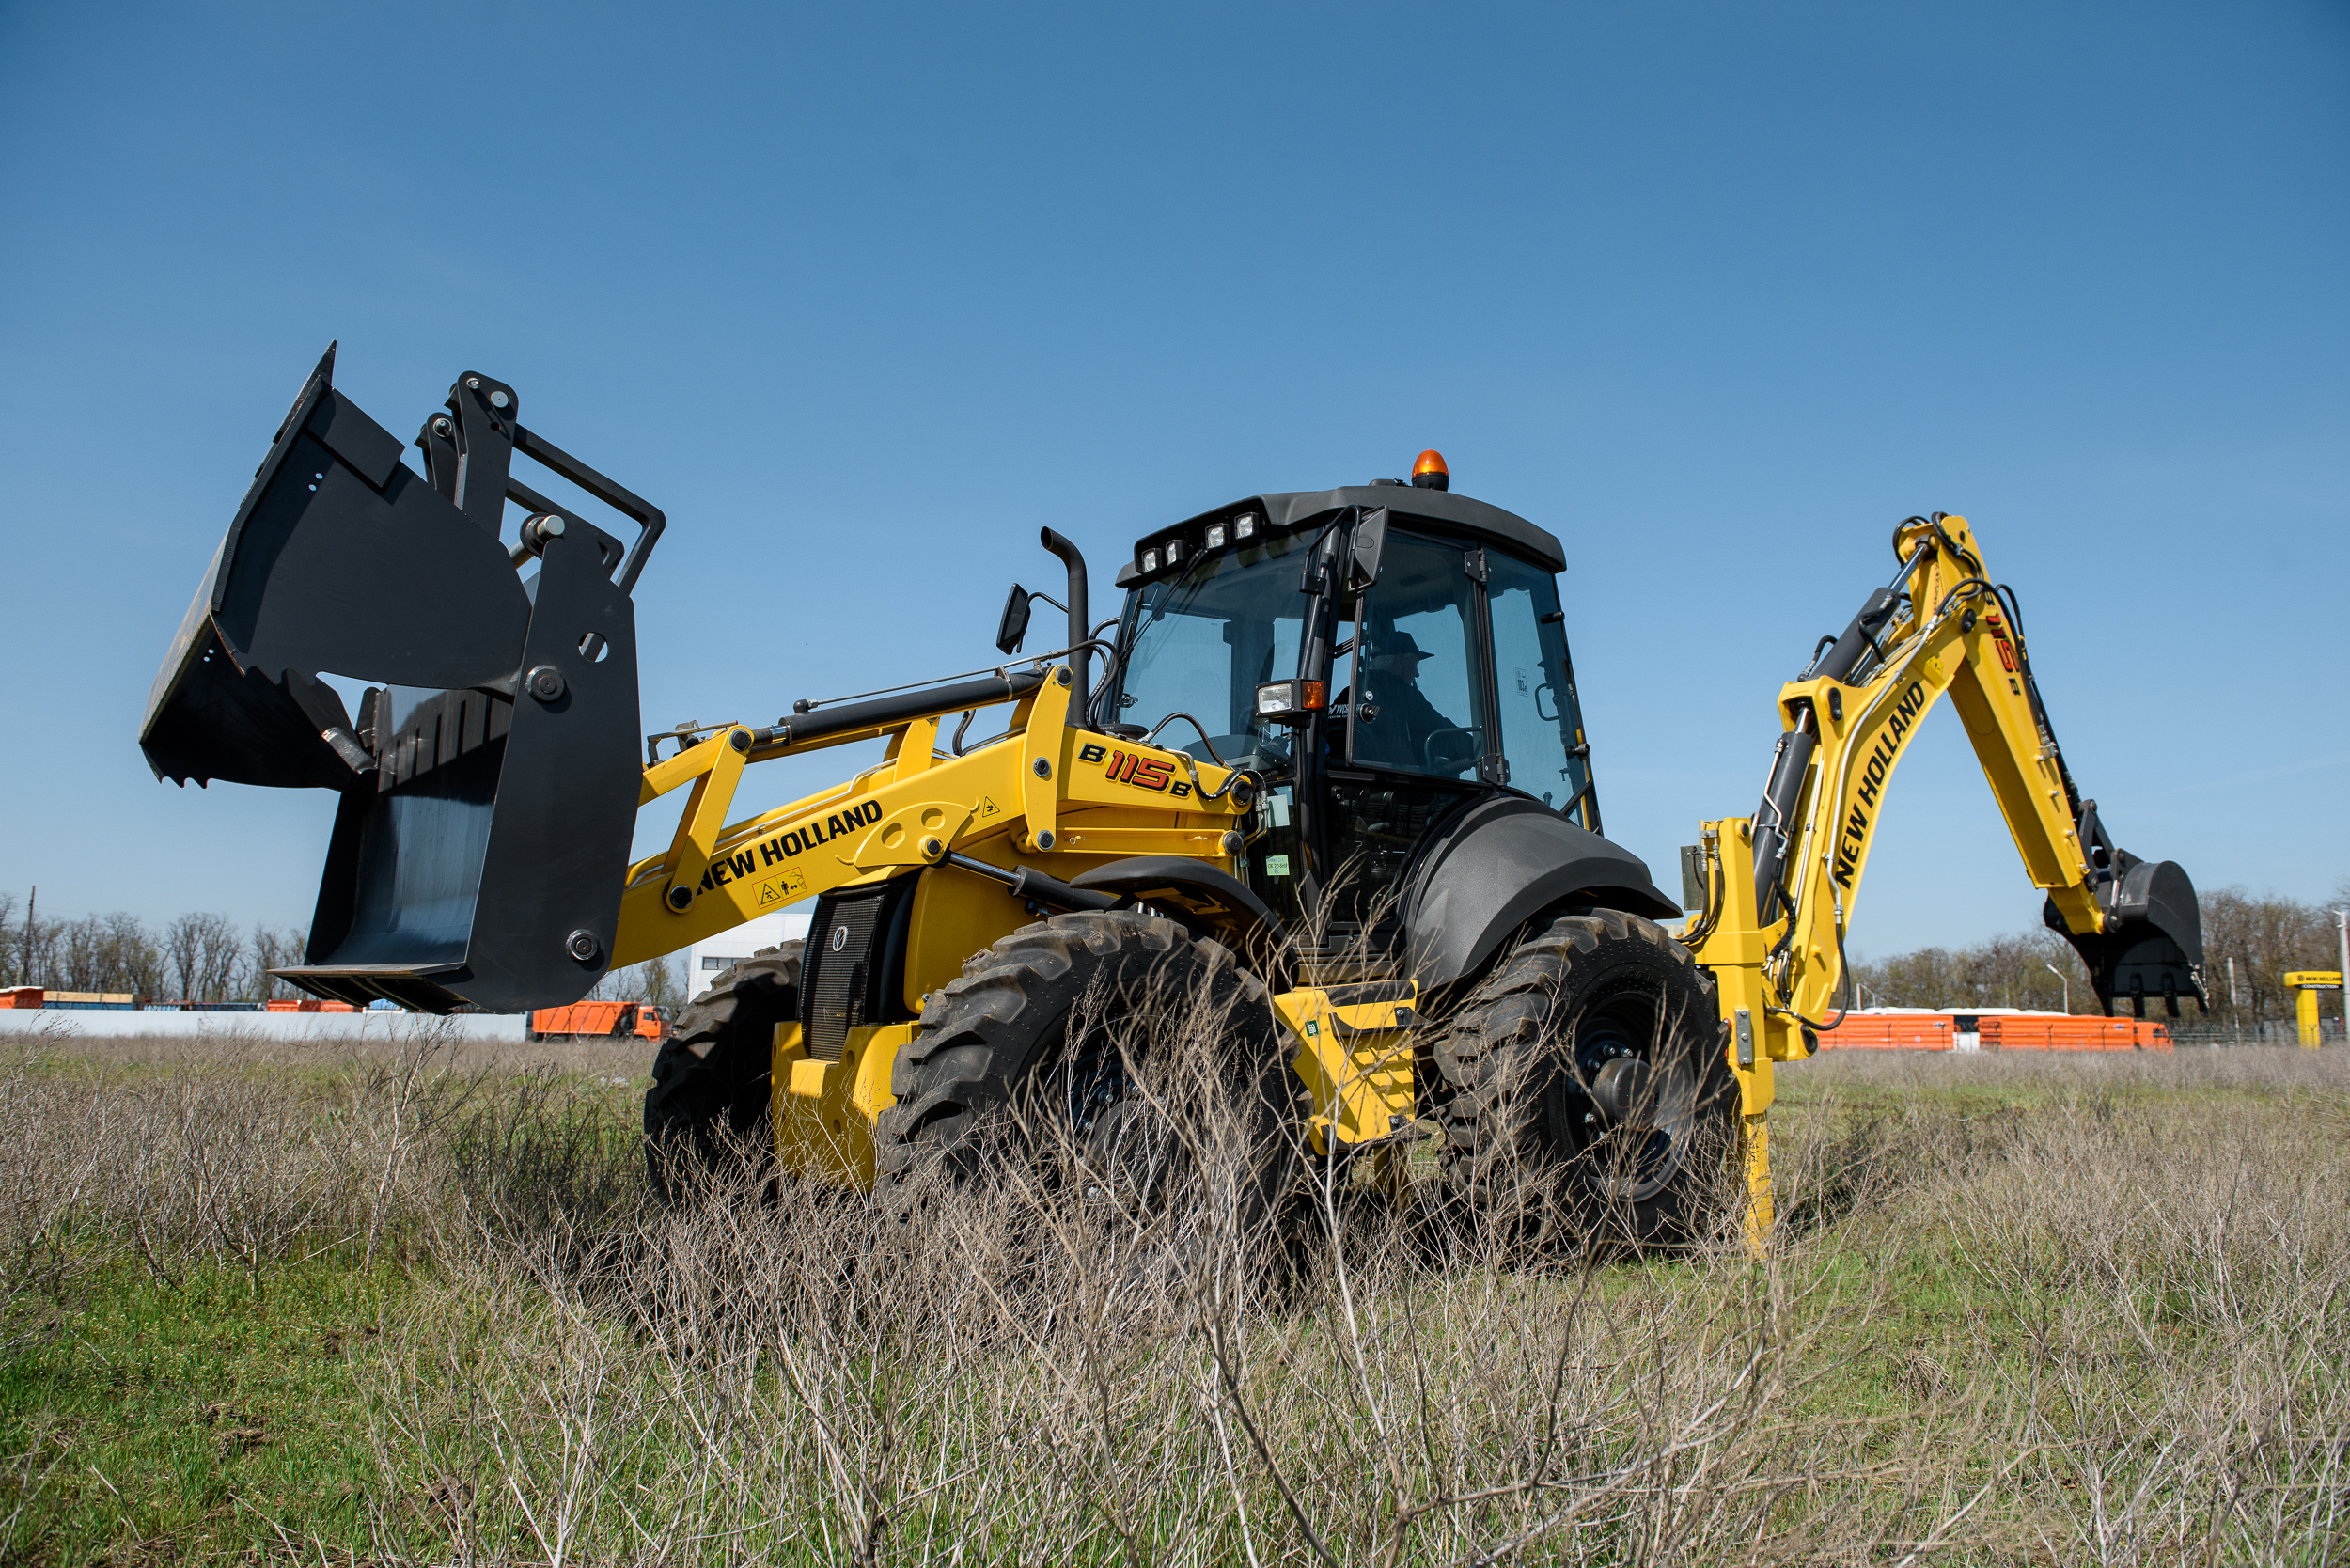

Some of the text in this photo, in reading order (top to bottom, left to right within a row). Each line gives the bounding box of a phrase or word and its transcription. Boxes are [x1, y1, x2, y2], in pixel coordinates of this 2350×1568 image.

[697, 799, 883, 897] NEW HOLLAND
[1835, 681, 1925, 890] NEW HOLLAND
